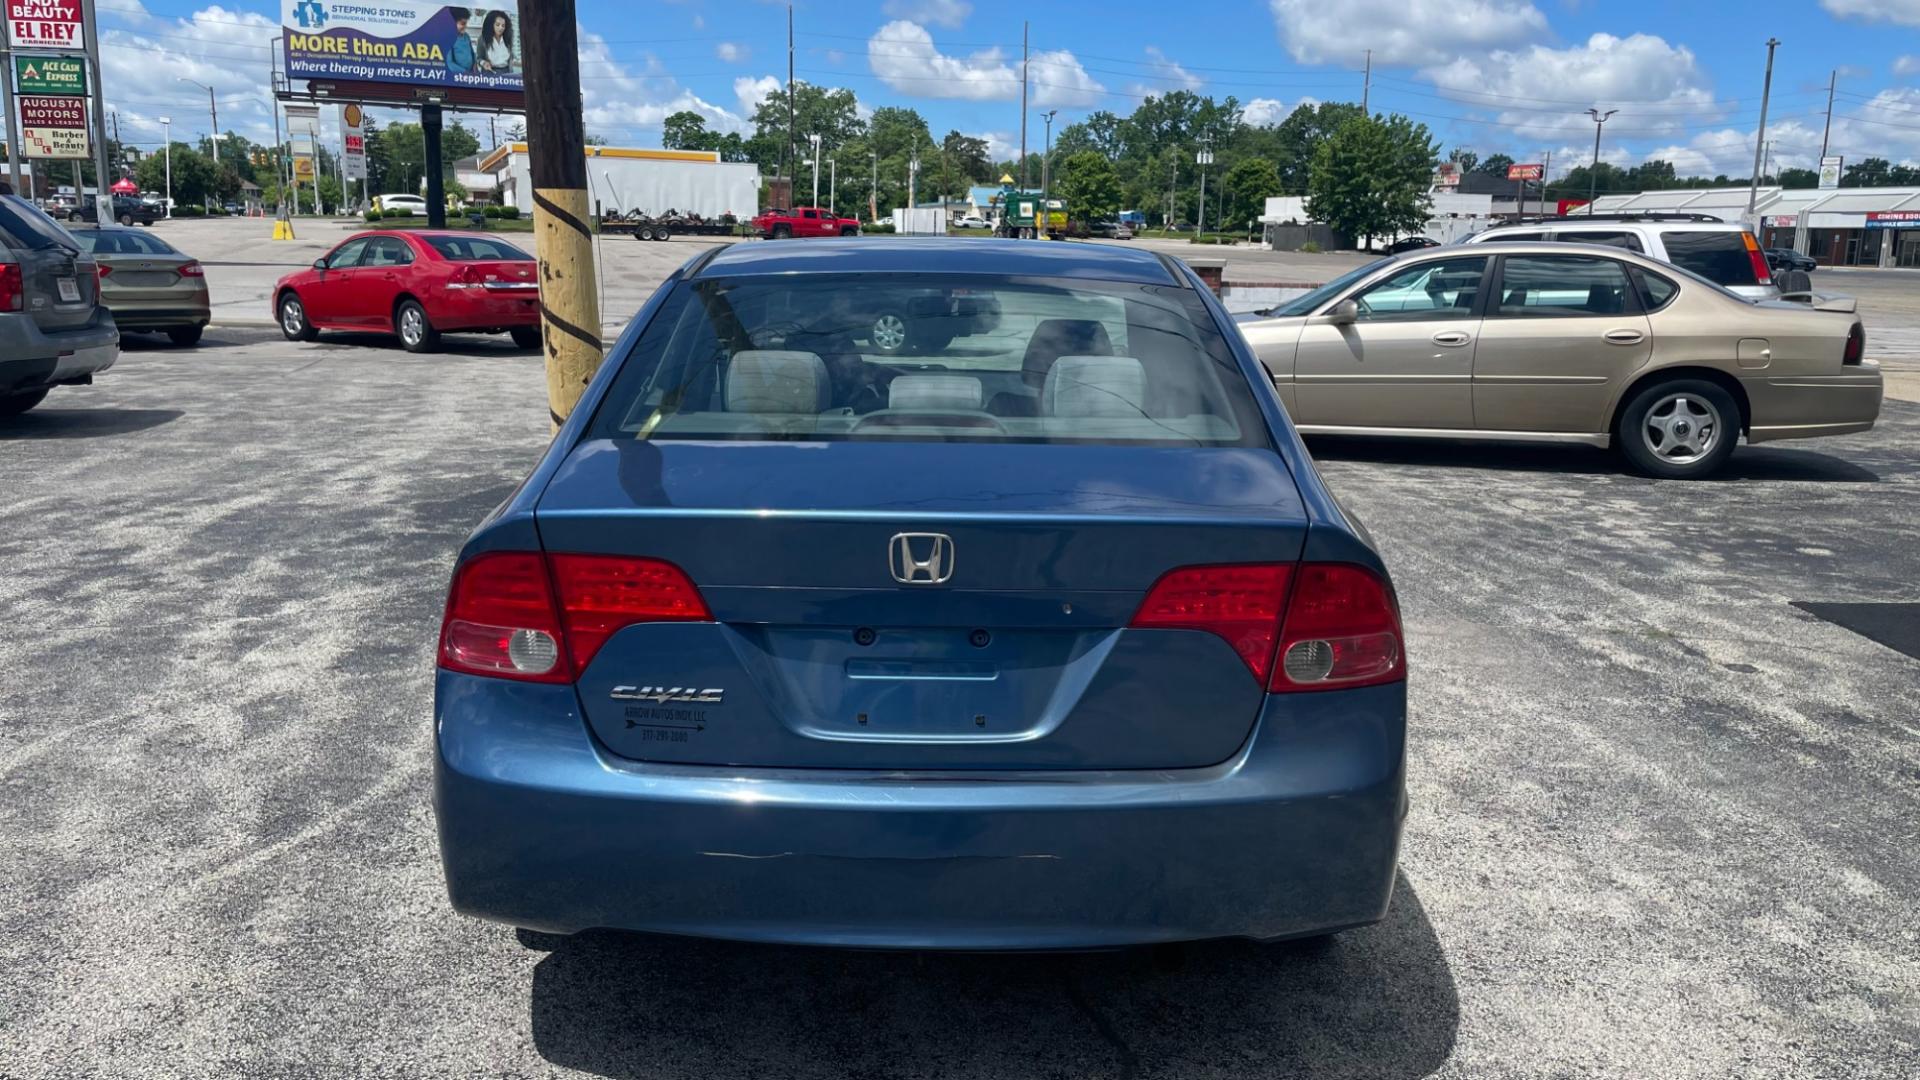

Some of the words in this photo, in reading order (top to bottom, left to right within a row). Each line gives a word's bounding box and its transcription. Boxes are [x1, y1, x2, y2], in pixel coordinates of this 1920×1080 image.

[12, 5, 75, 19] BEAUTY
[331, 5, 377, 16] STEPPING
[379, 8, 416, 19] STONES
[15, 22, 35, 38] EL
[40, 23, 75, 40] REY
[290, 35, 348, 54] MORE
[353, 38, 398, 57] than
[402, 42, 444, 61] ABA
[42, 62, 59, 71] ACE
[290, 61, 327, 72] Where
[330, 62, 375, 77] therapy
[377, 67, 411, 78] meets
[413, 69, 446, 80] PLAY!
[23, 99, 81, 108] AUGUSTA
[27, 109, 79, 119] MOTORS
[52, 131, 84, 139] Barber
[53, 141, 85, 150] Beauty
[610, 685, 724, 704] CIVIC
